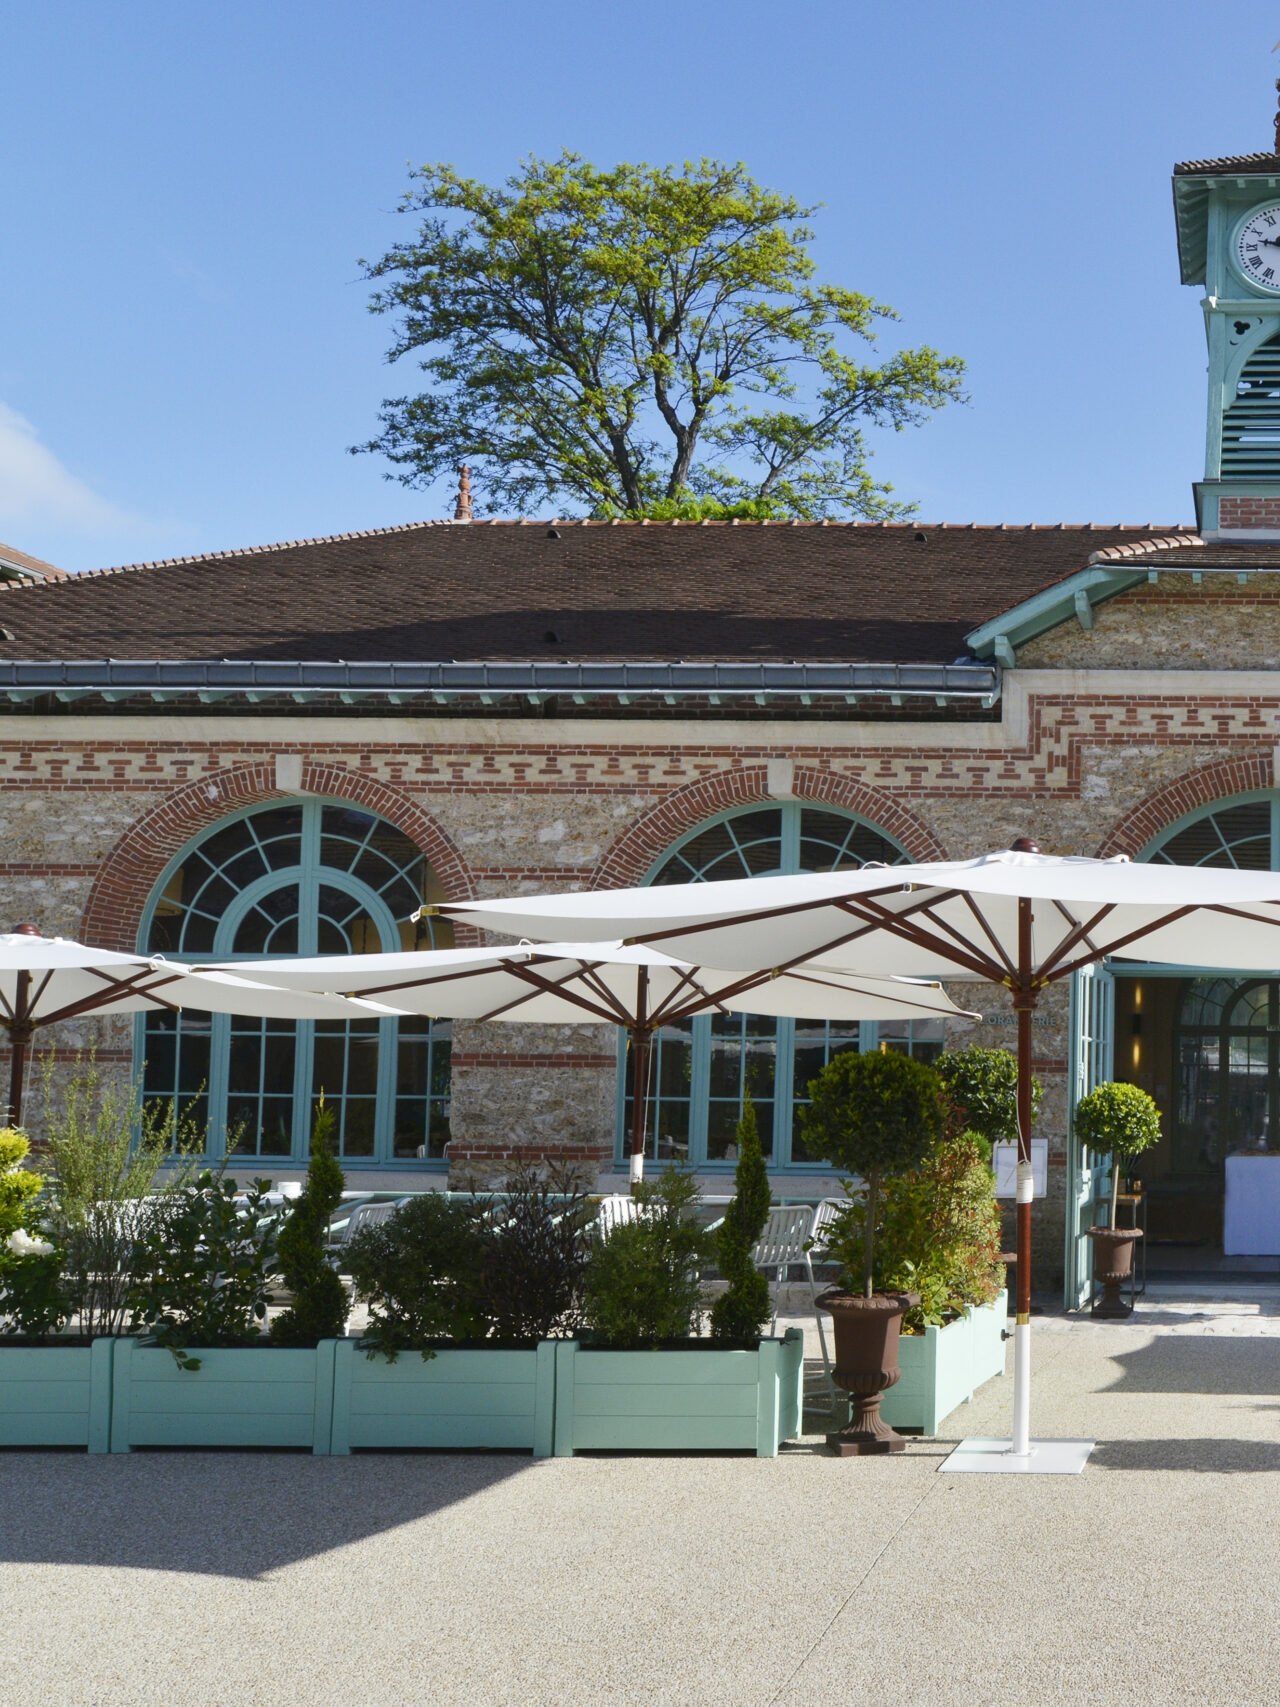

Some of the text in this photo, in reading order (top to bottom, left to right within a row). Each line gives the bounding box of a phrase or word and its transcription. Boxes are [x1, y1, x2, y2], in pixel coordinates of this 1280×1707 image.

[1263, 215, 1277, 227] XI
[1251, 227, 1263, 237] X
[1246, 243, 1258, 252] IX
[1262, 267, 1275, 280] VII
